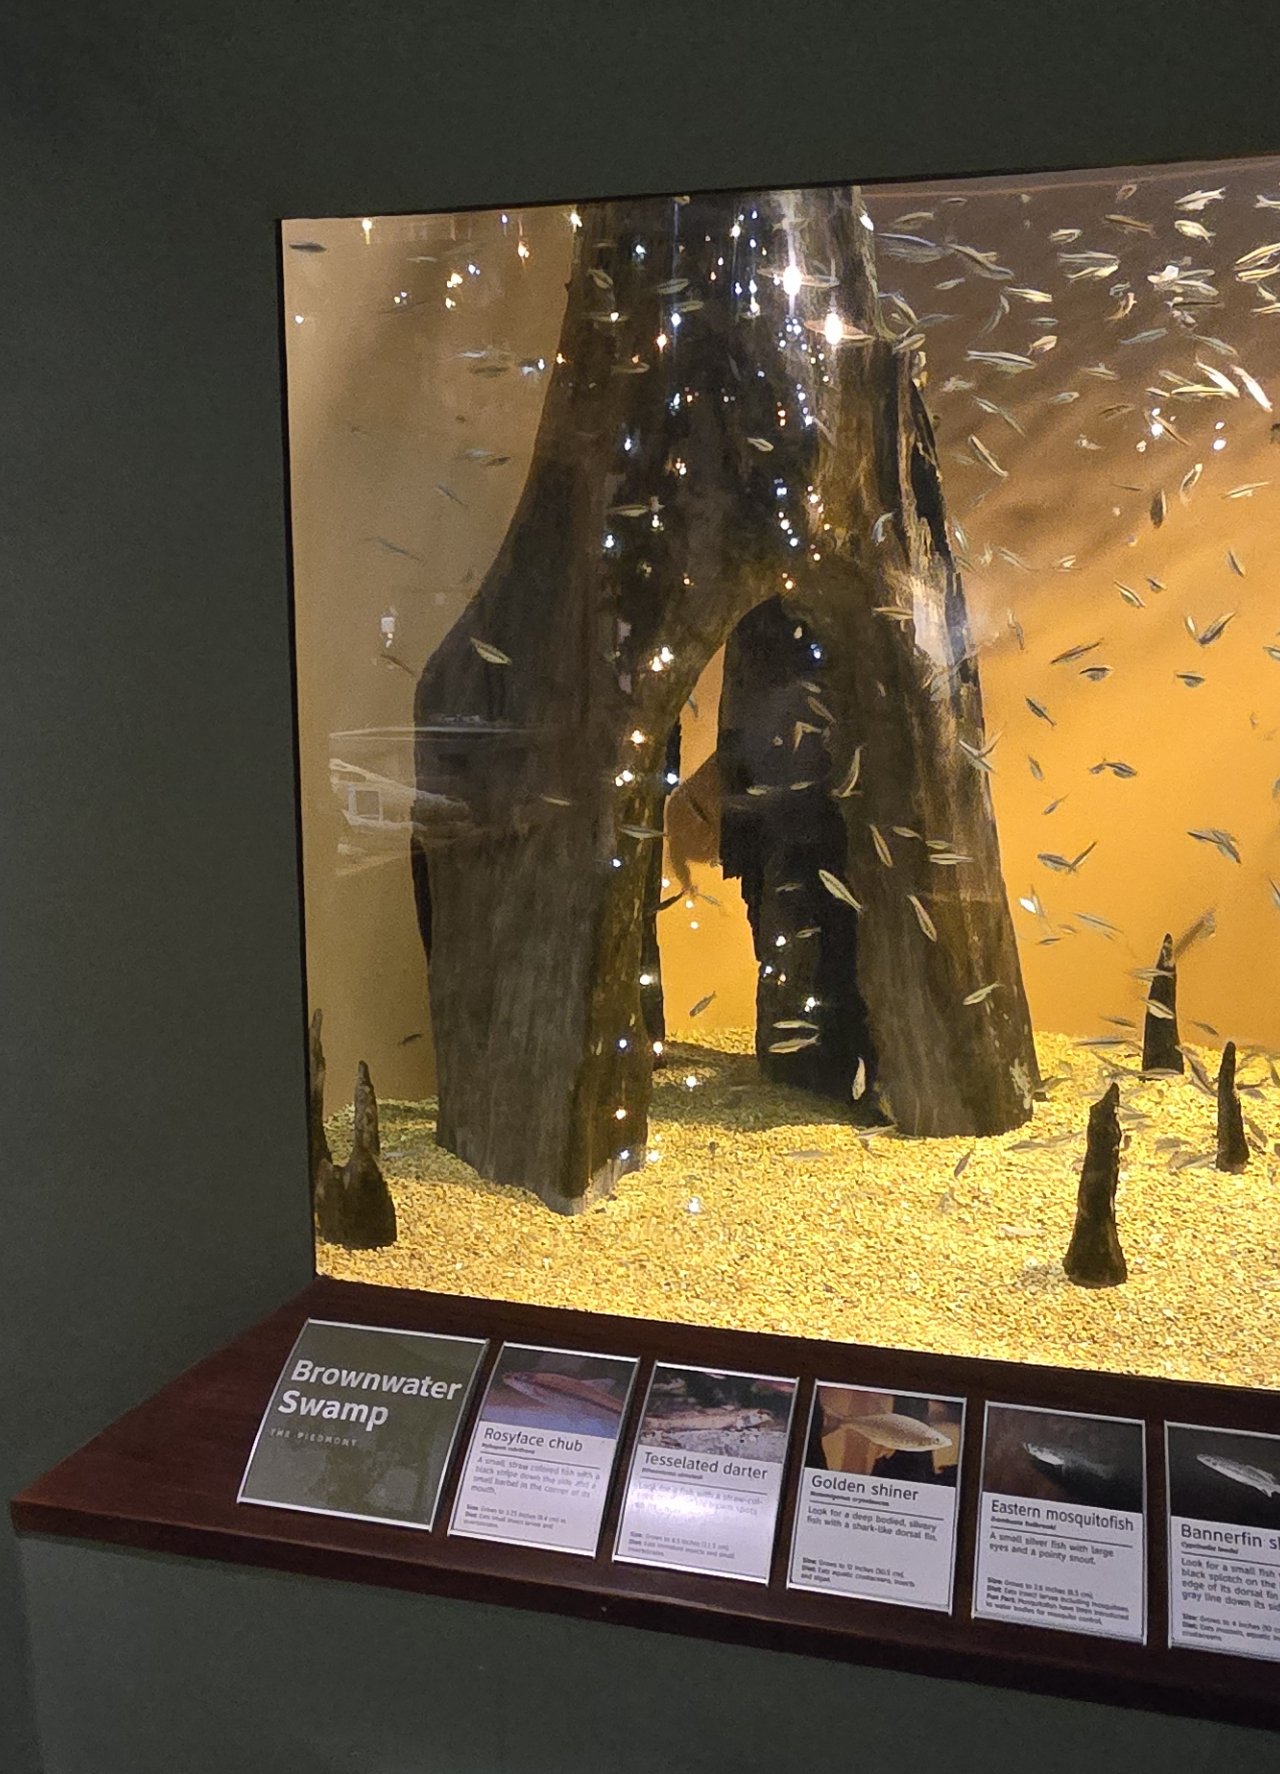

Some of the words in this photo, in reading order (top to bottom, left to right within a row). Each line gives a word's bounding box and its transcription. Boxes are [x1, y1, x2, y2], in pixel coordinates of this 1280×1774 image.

[292, 1360, 462, 1400] Brownwater
[279, 1391, 389, 1432] Swamp
[271, 1429, 291, 1438] THE
[298, 1432, 357, 1447] PIEDMONT
[485, 1428, 545, 1447] Rosyface
[549, 1437, 583, 1452] chub
[646, 1452, 719, 1473] Tesselated
[724, 1463, 768, 1480] darter
[812, 1475, 866, 1494] Golden
[872, 1484, 919, 1501] shiner
[808, 1506, 828, 1516] Look
[831, 1509, 842, 1517] for
[852, 1512, 873, 1523] deep
[992, 1500, 1041, 1518] Eastern
[1047, 1510, 1134, 1531] mosquitofish
[807, 1516, 822, 1525] fish
[896, 1529, 922, 1539] dorsal
[925, 1533, 938, 1542] fin.
[1182, 1524, 1263, 1548] Bannerfin
[990, 1532, 997, 1540] A
[999, 1535, 1023, 1544] small
[1026, 1538, 1048, 1547] silver
[1052, 1540, 1067, 1550] fish
[1070, 1545, 1089, 1553] with
[1091, 1546, 1114, 1559] large
[990, 1543, 1009, 1553] eyes
[1012, 1547, 1028, 1555] and
[1039, 1551, 1067, 1563] pointy
[1181, 1558, 1203, 1568] Look
[1206, 1561, 1220, 1570] for
[1231, 1566, 1256, 1575] small
[1259, 1569, 1276, 1578] fish
[1182, 1569, 1206, 1579] black
[1209, 1574, 1243, 1584] splotch
[1261, 1580, 1277, 1589] the
[1182, 1581, 1205, 1591] edge
[1208, 1584, 1218, 1592] of
[1221, 1586, 1232, 1594] its
[1235, 1588, 1263, 1598] dorsal
[1267, 1591, 1279, 1600] fin
[1182, 1592, 1202, 1602] gray
[1205, 1594, 1222, 1604] line
[1225, 1597, 1251, 1607] down
[1254, 1601, 1266, 1610] its
